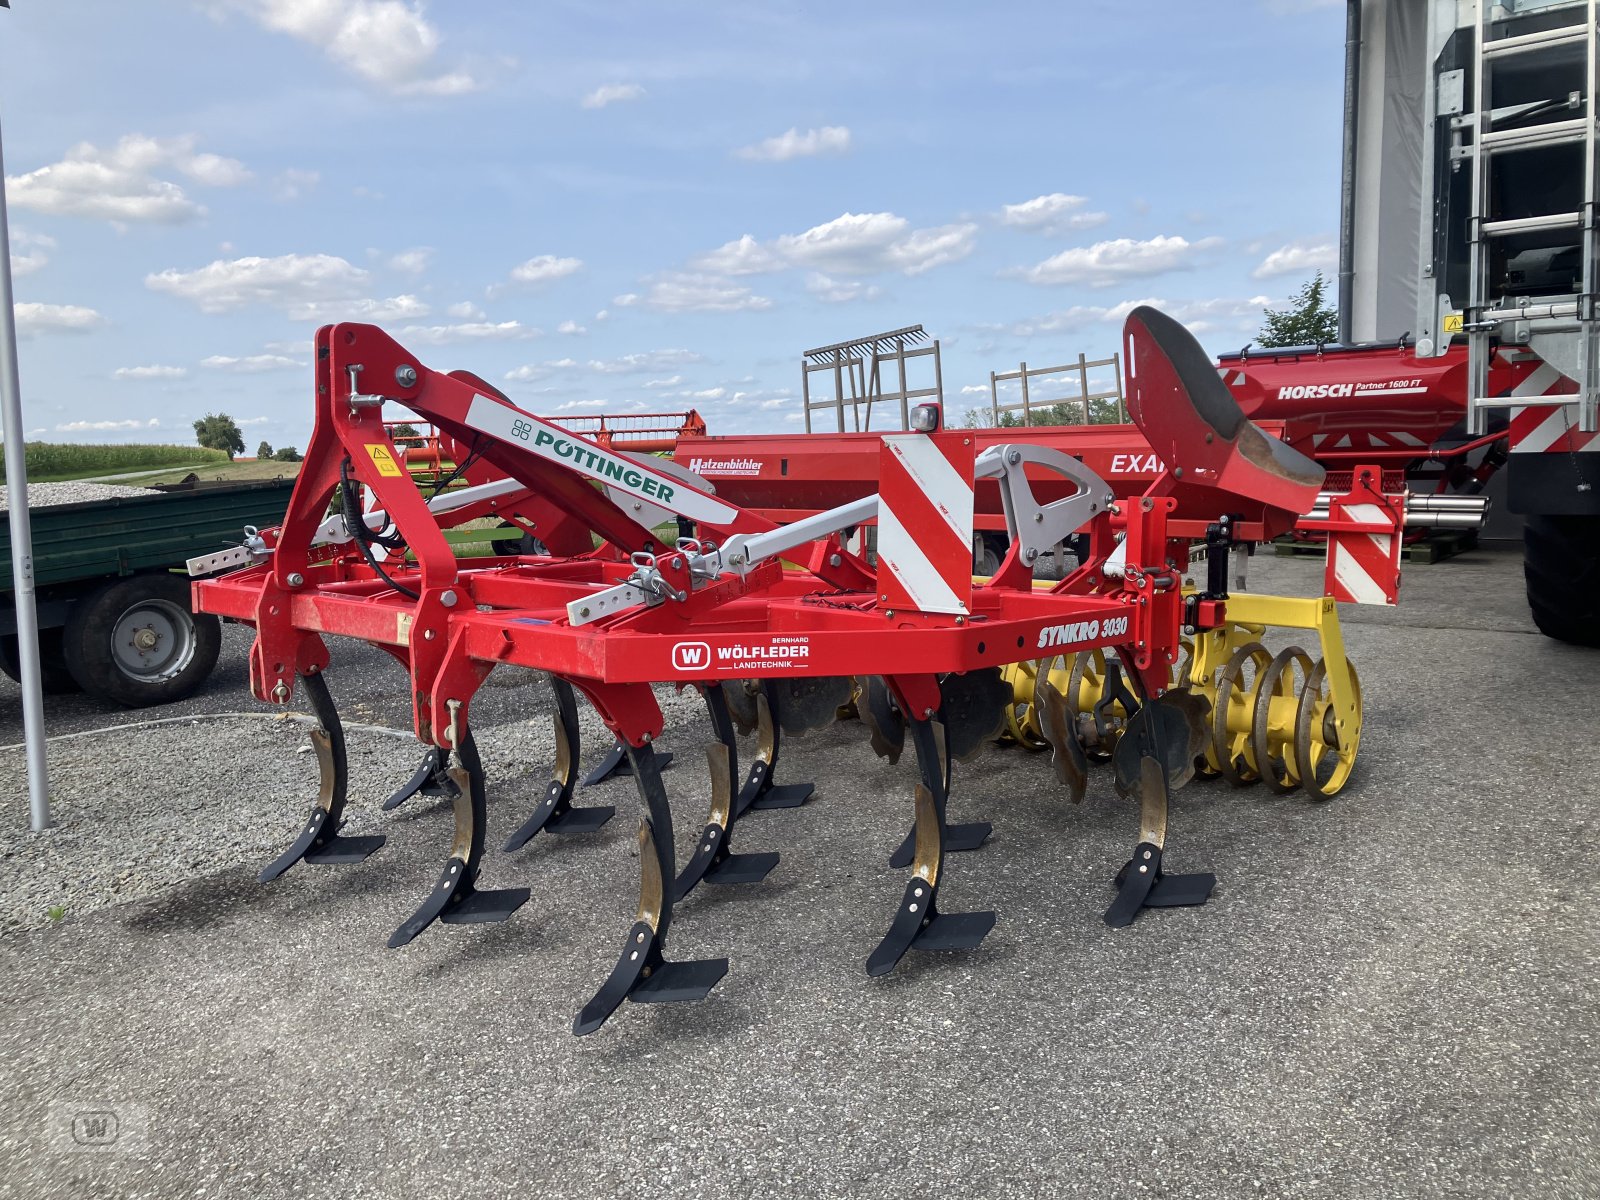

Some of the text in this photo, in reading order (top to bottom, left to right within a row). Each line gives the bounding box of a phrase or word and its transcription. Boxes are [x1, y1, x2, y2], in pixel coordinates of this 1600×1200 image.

[1278, 383, 1353, 400] HORSCH
[1356, 379, 1422, 390] Partner 1600 FT
[689, 458, 763, 475] Hatzenbichler
[1036, 616, 1128, 648] SYNKRO 3030
[681, 648, 702, 664] W
[717, 644, 809, 659] WÖLFLEDER
[733, 661, 793, 669] LANDTECHNIK
